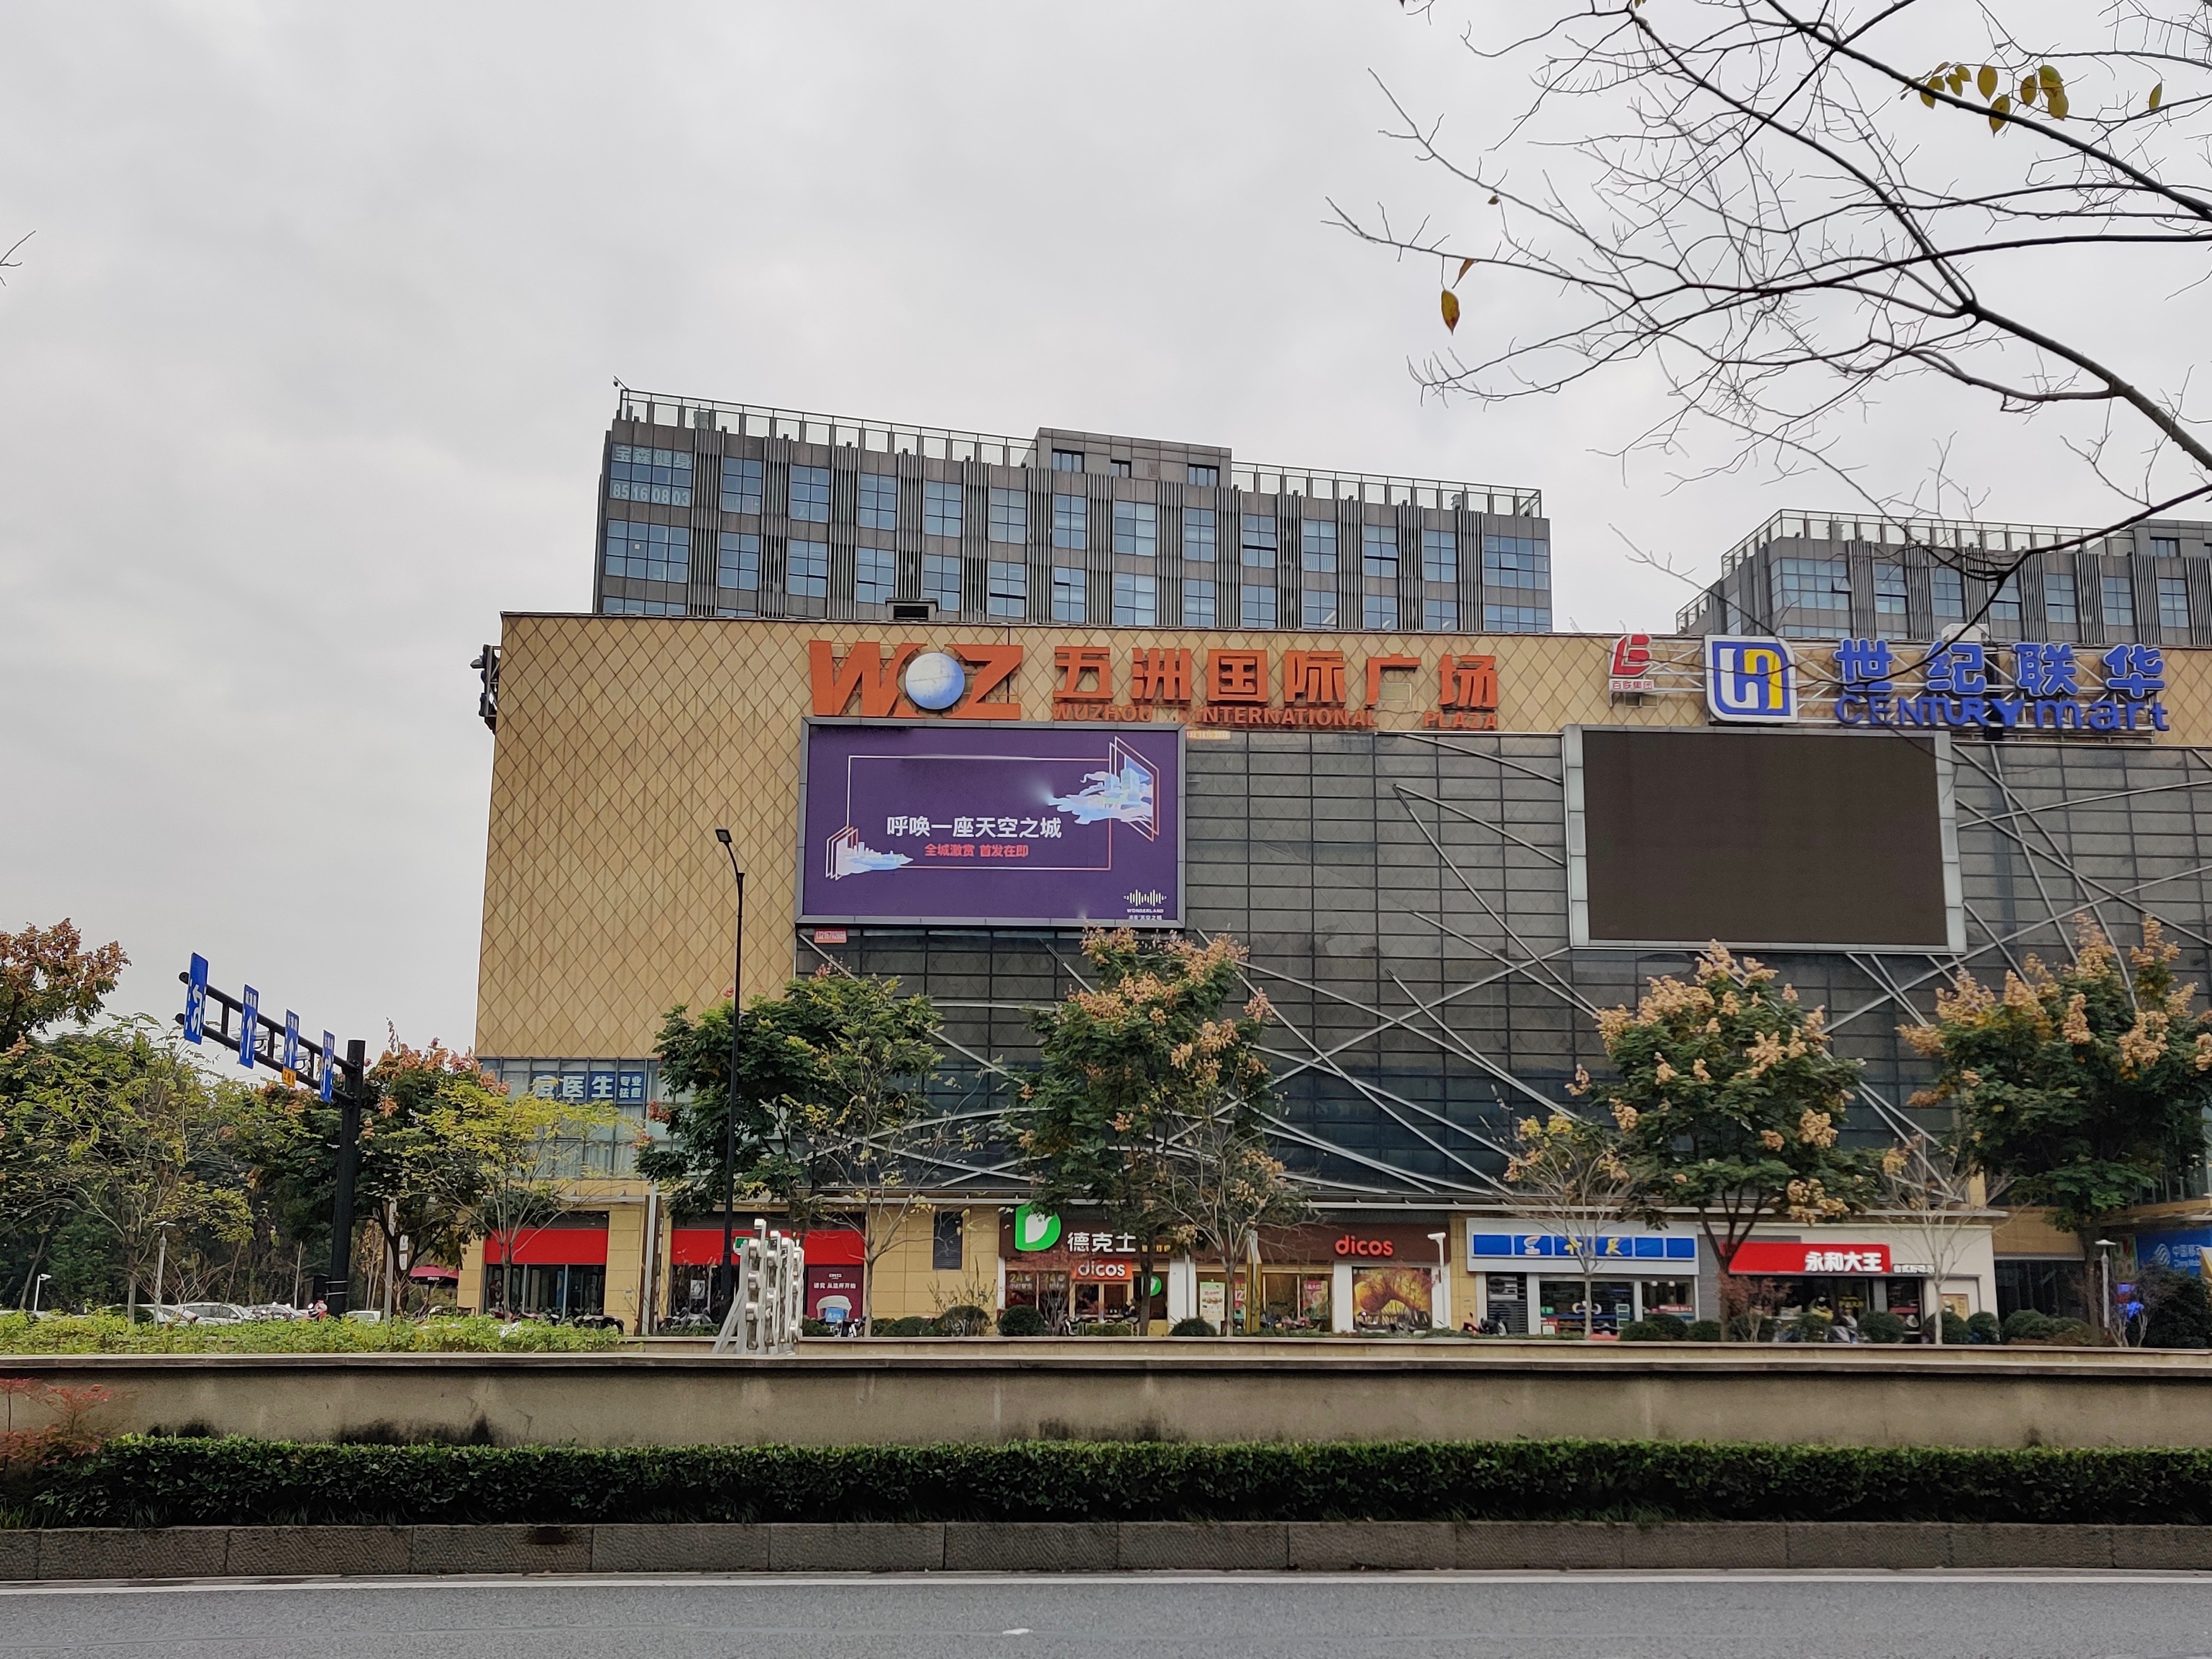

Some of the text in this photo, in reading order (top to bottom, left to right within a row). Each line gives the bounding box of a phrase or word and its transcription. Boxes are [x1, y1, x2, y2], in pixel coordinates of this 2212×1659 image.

[615, 445, 691, 469] 宝森健身
[613, 483, 690, 506] 85160803
[1052, 645, 1498, 708] 五洲国际广场
[1833, 638, 2167, 699] 世纪联华
[1052, 702, 1498, 729] WUZHOU INTERNATIONAL PLAZA
[1834, 694, 2170, 732] CENTURY mart
[886, 815, 1062, 838] 呼唤一座天空之城
[979, 844, 1029, 857] 首发在即
[620, 1076, 641, 1086] 专业
[1067, 1232, 1136, 1253] 德克士
[1335, 1235, 1394, 1256] dicos
[1078, 1261, 1126, 1277] dicos
[1805, 1251, 1883, 1272] 永和大王
